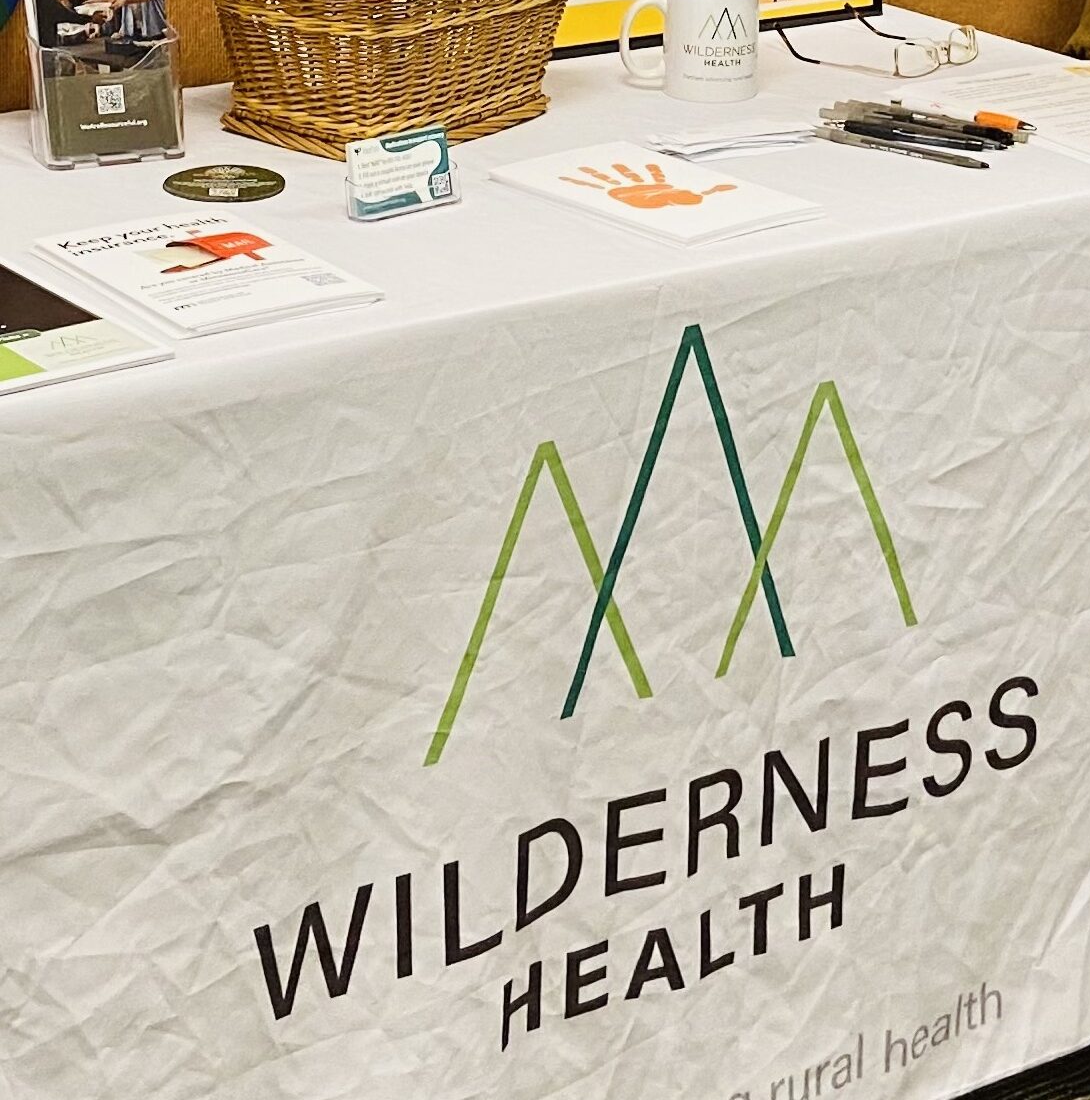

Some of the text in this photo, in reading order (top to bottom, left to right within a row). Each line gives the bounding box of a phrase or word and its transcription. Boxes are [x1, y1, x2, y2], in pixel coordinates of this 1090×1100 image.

[704, 59, 741, 67] HEALTH
[57, 216, 228, 250] Keep your health
[253, 675, 1040, 1020] WILDERNESS
[501, 863, 846, 1051] HEALTH
[770, 981, 1002, 1100] rural health
